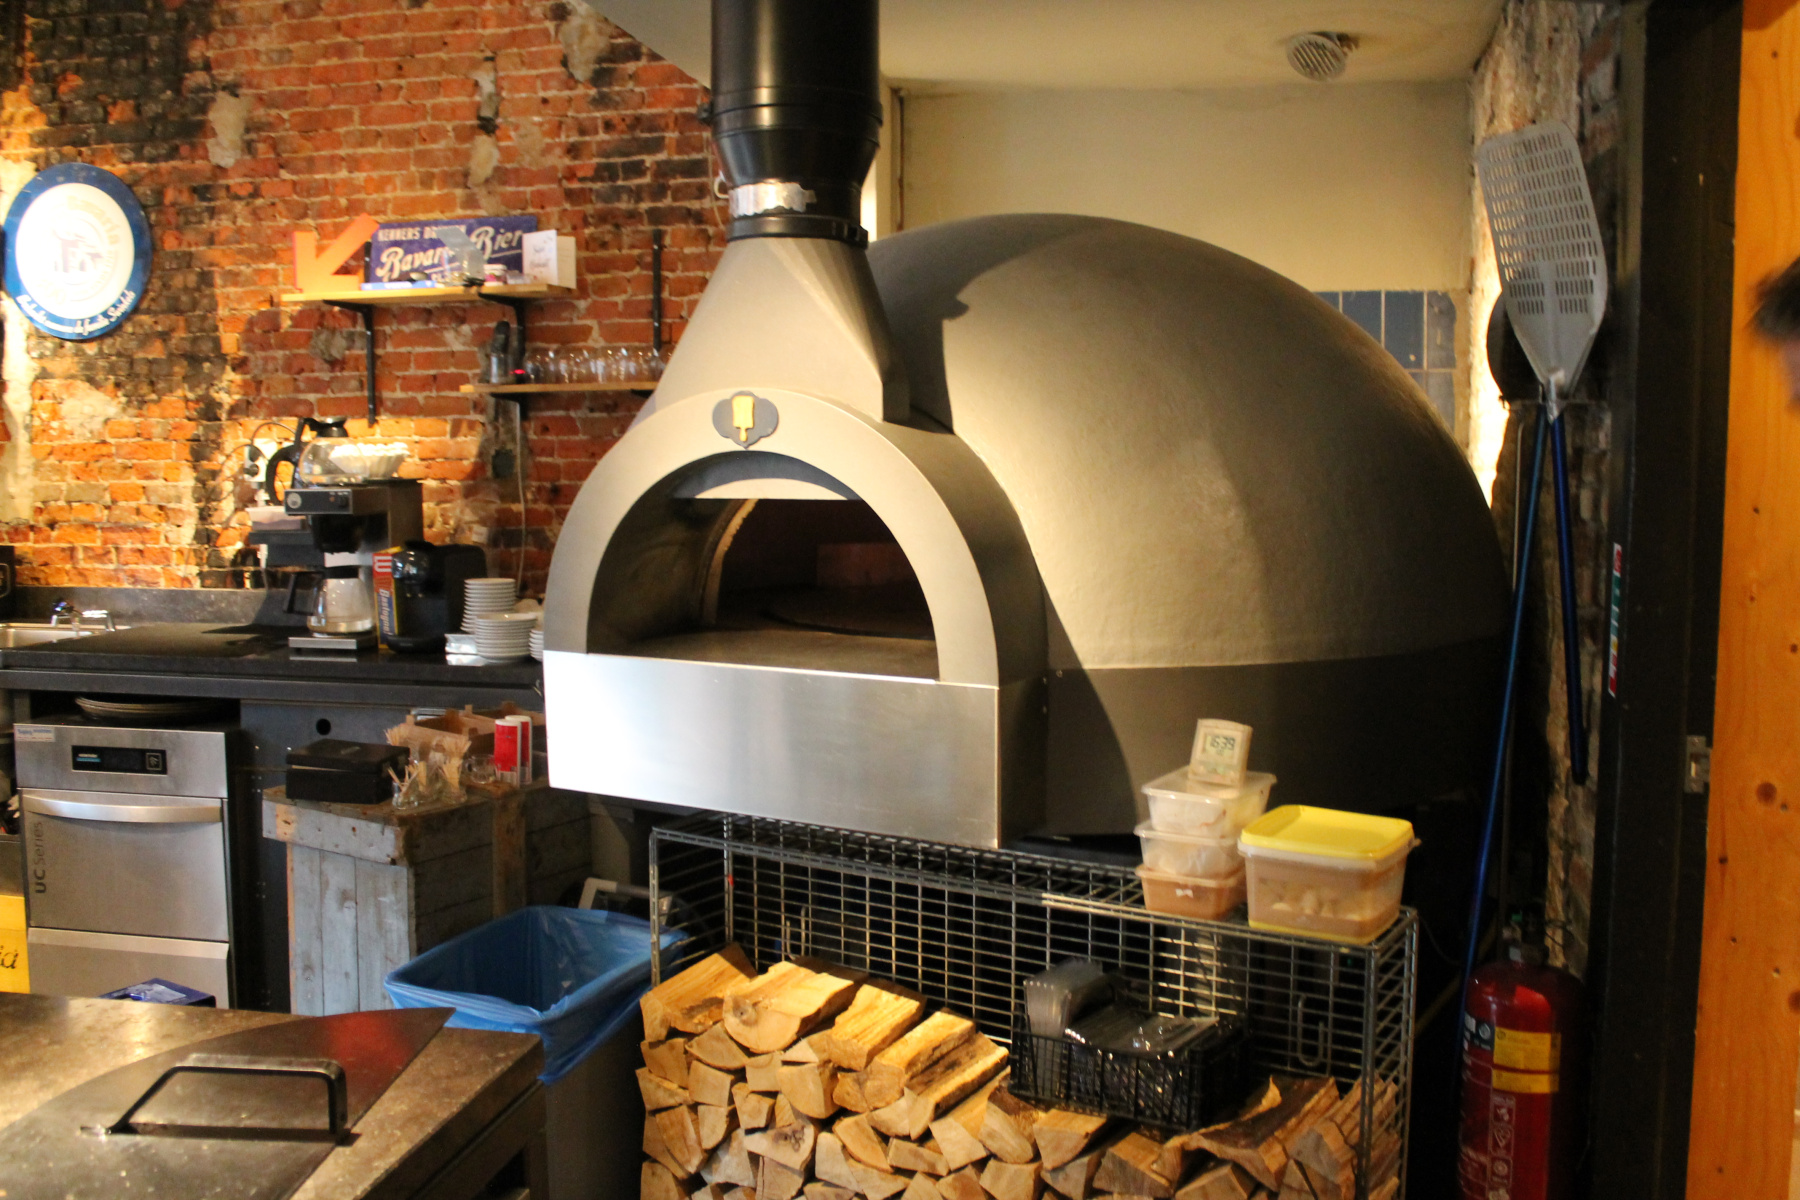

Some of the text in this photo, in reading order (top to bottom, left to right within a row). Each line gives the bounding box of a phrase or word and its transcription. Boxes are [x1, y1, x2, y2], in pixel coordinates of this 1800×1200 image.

[375, 246, 455, 282] Bavar
[470, 226, 524, 260] Bier
[33, 821, 46, 893] UC Series
